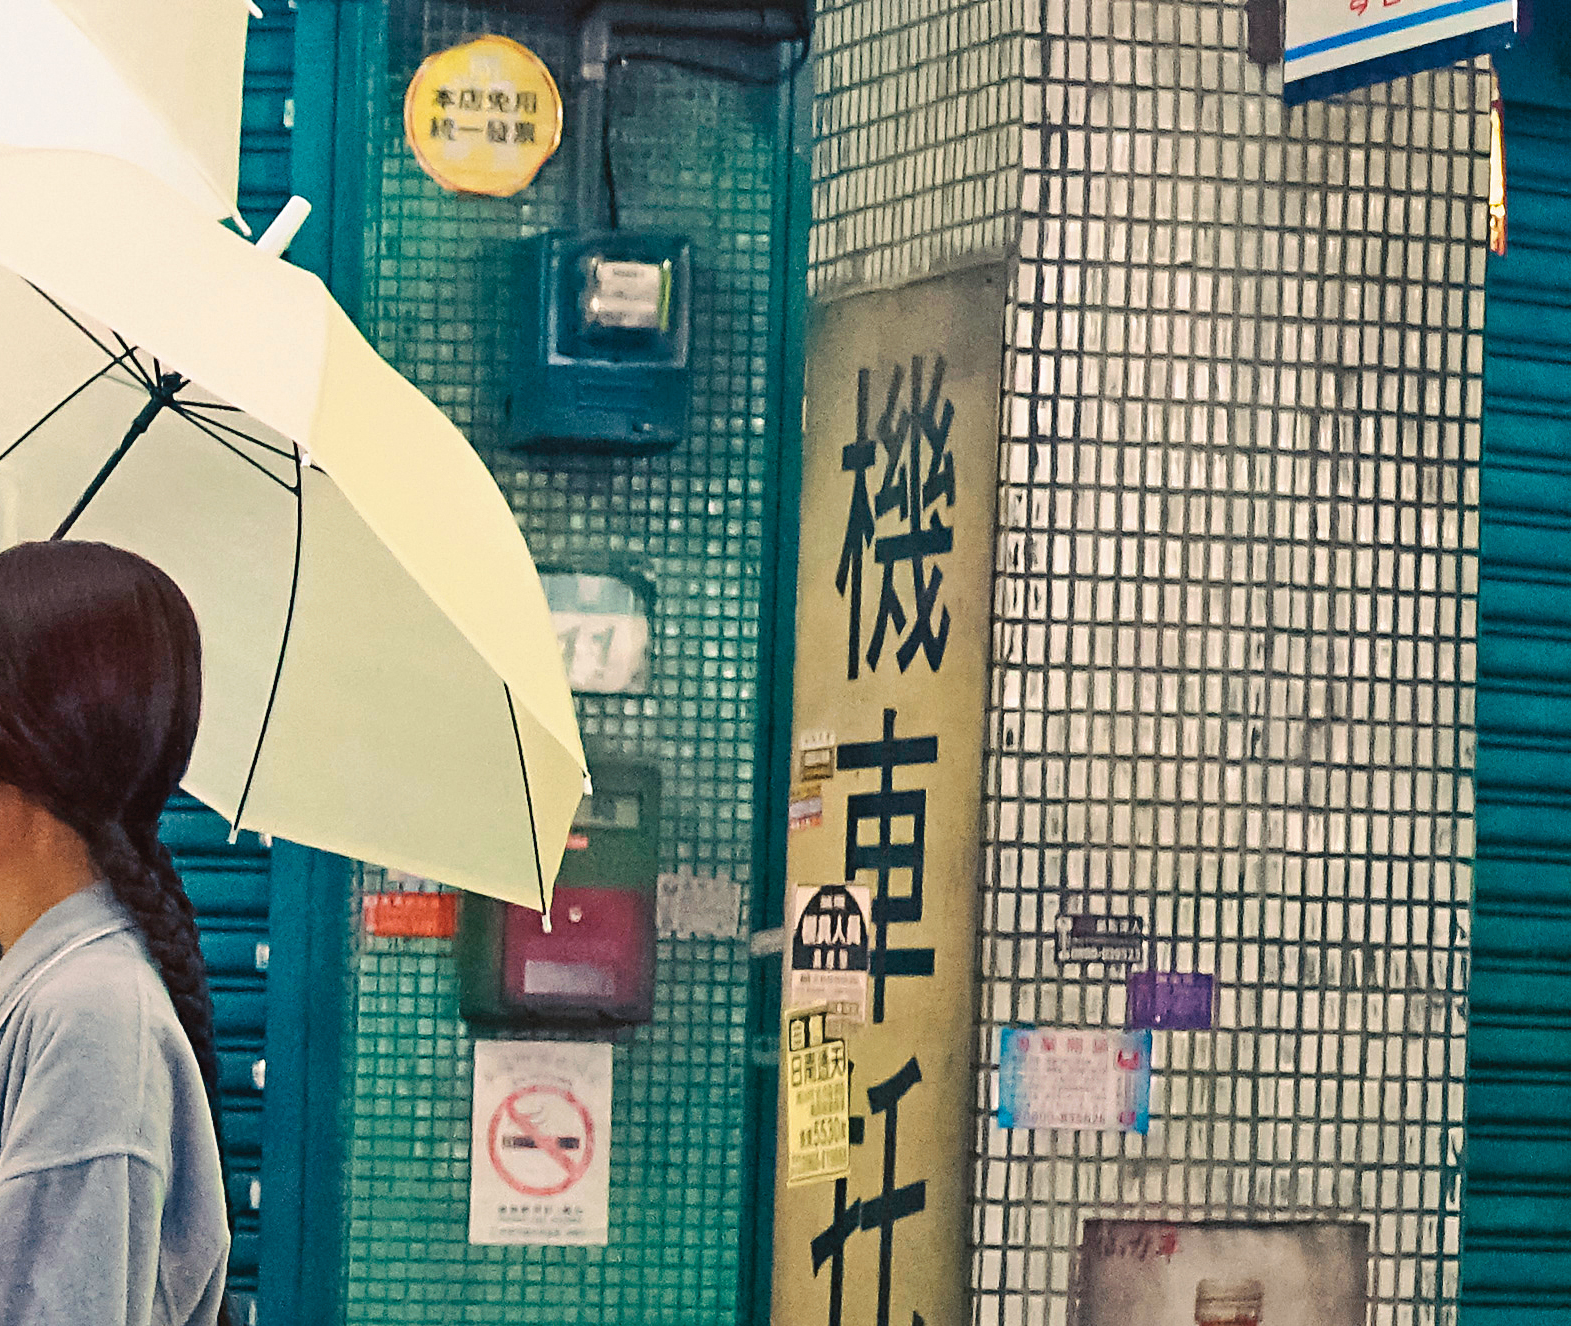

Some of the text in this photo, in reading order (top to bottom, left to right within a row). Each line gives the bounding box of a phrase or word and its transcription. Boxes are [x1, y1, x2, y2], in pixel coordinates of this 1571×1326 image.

[433, 89, 536, 114] 本店免用
[430, 117, 536, 143] 統一發票
[557, 624, 615, 678] 11
